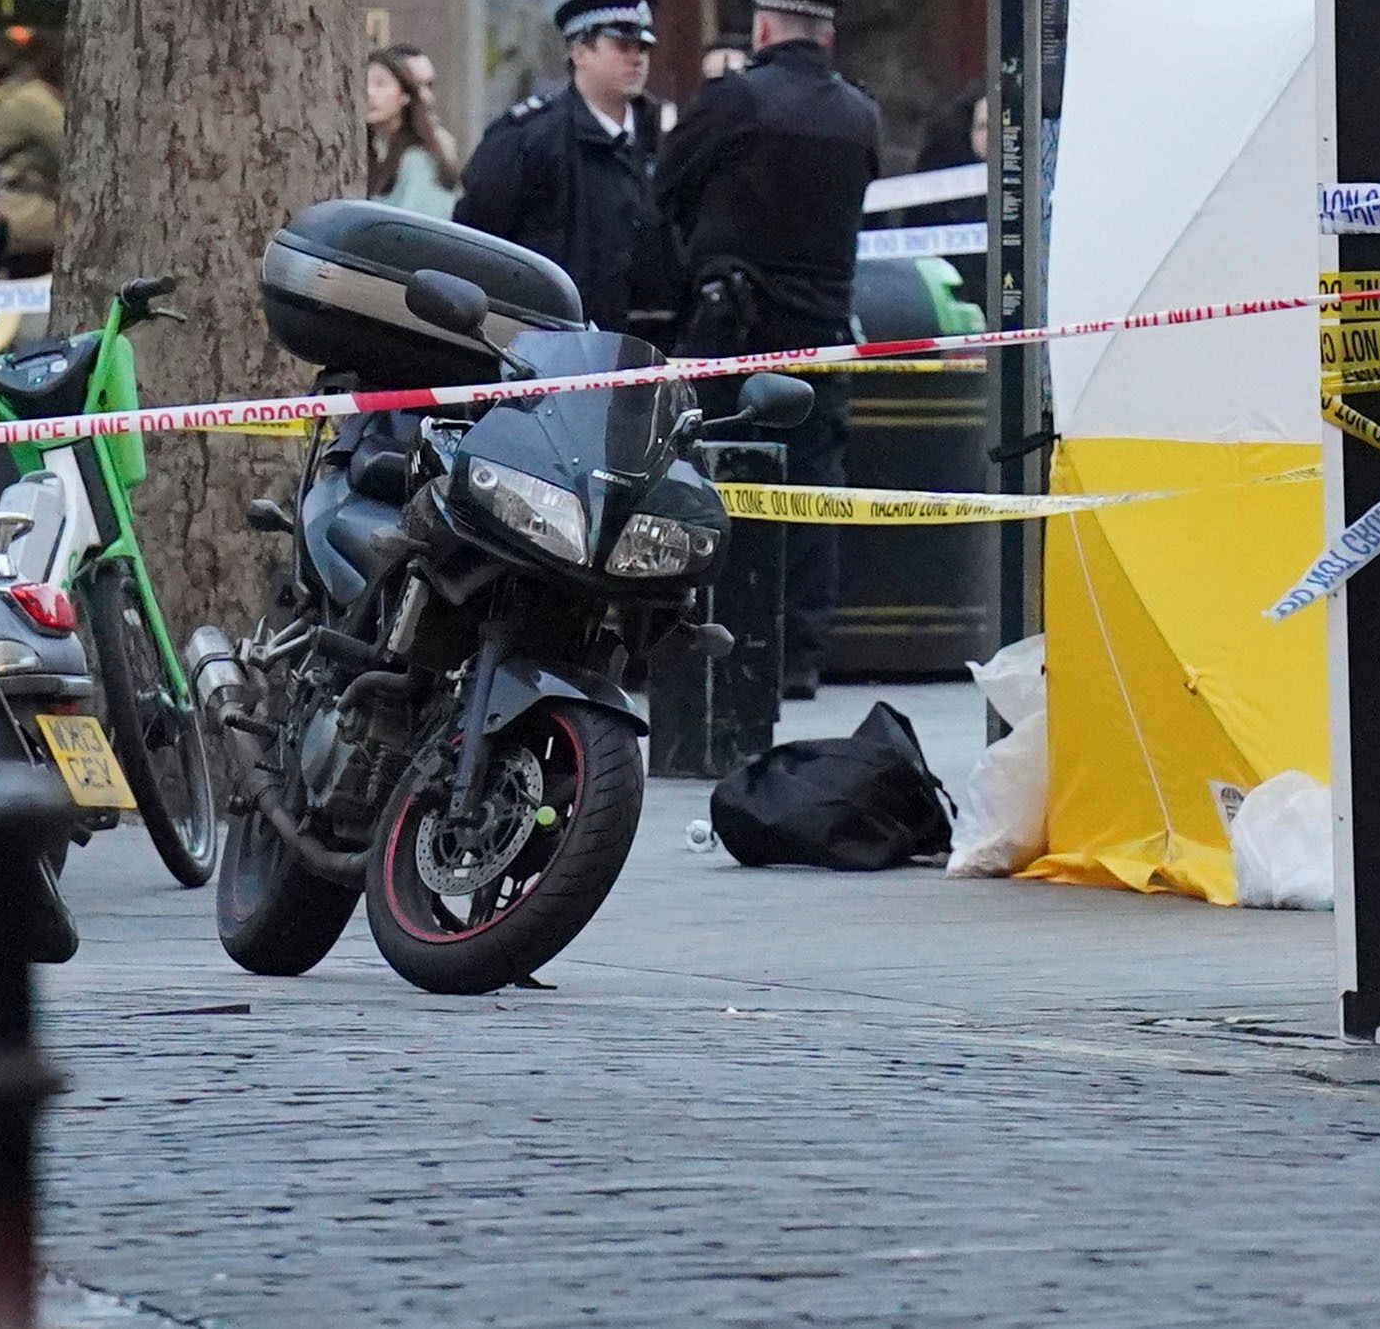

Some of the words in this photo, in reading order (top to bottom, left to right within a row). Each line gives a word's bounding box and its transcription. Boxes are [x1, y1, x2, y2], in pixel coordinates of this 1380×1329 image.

[1341, 329, 1379, 363] NOT
[140, 411, 176, 434] DO
[183, 407, 233, 429] NOT
[241, 400, 328, 423] CROSS
[734, 489, 766, 515] ZONE
[770, 489, 789, 516] DO
[790, 489, 816, 517] NOT
[817, 491, 855, 518] CROSS
